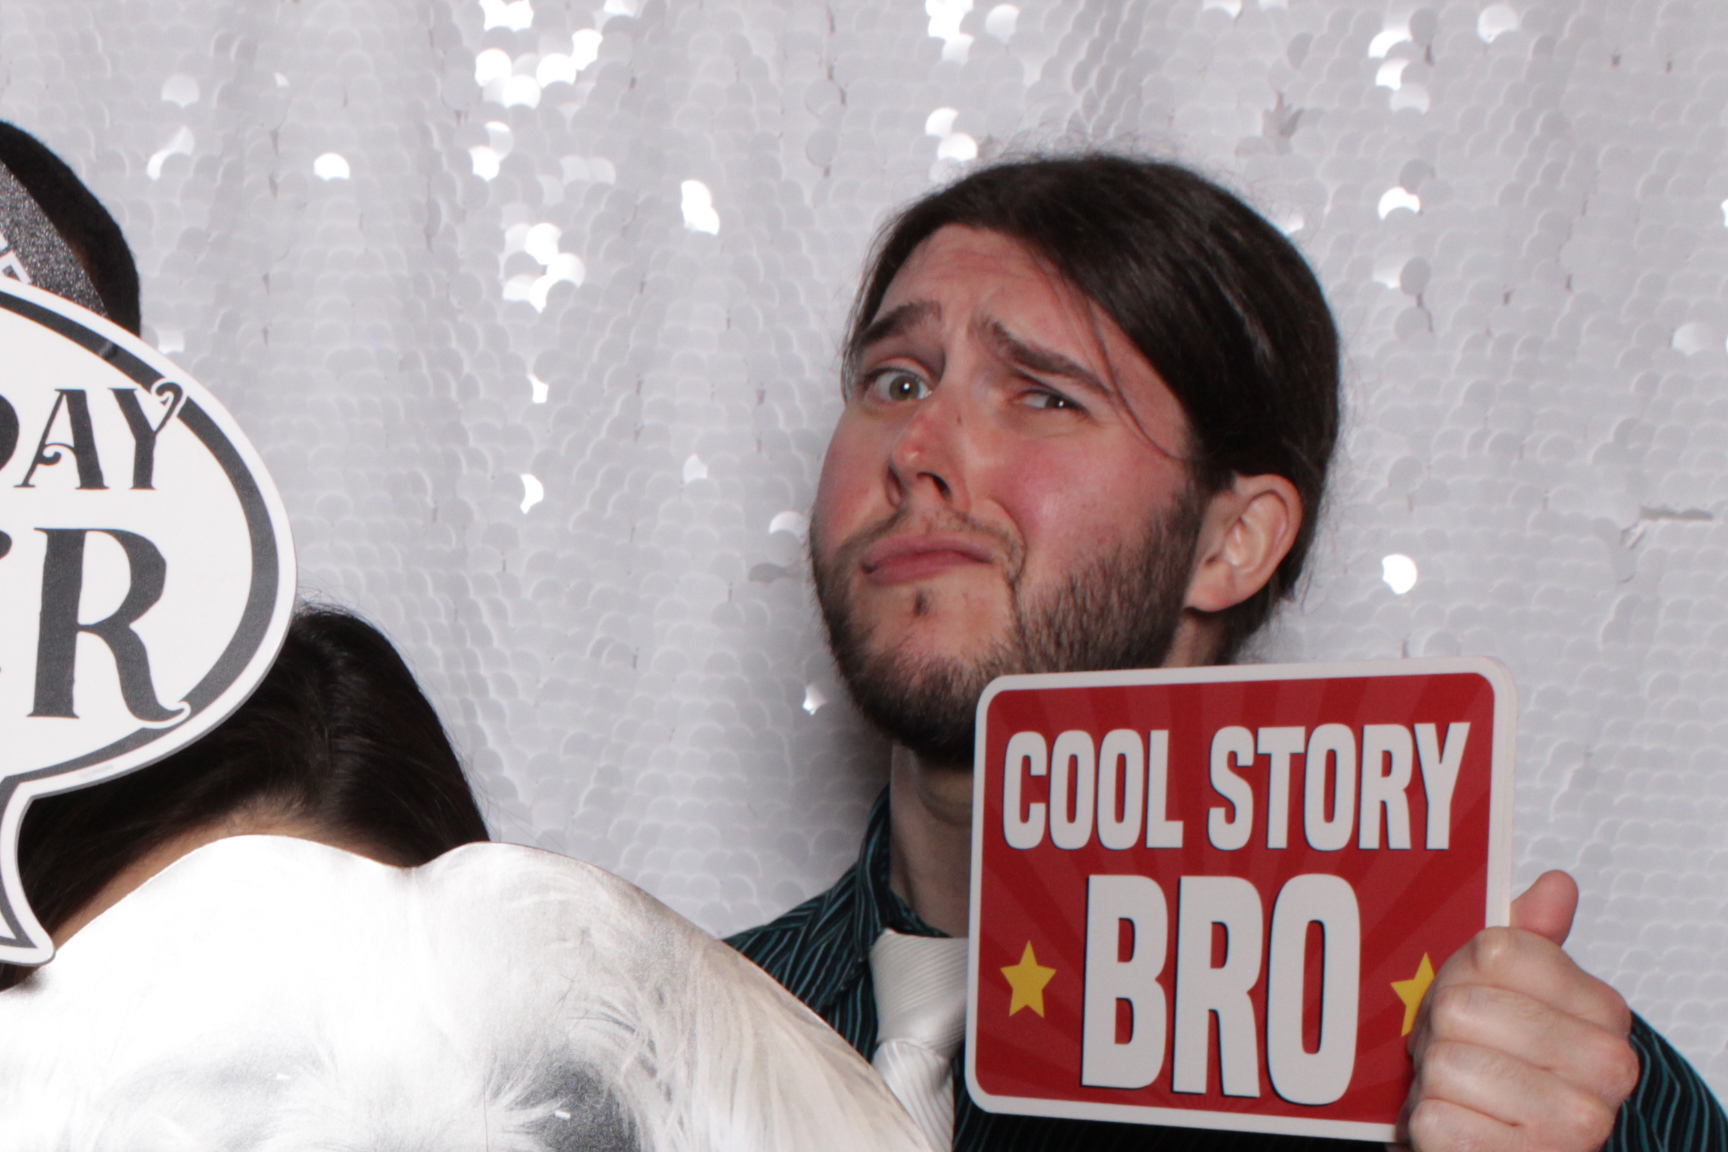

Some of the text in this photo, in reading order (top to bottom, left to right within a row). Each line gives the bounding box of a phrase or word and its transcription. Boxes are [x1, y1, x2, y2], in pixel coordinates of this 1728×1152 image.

[1002, 721, 1471, 852] COOL STORY
[1080, 873, 1361, 1106] BRO
